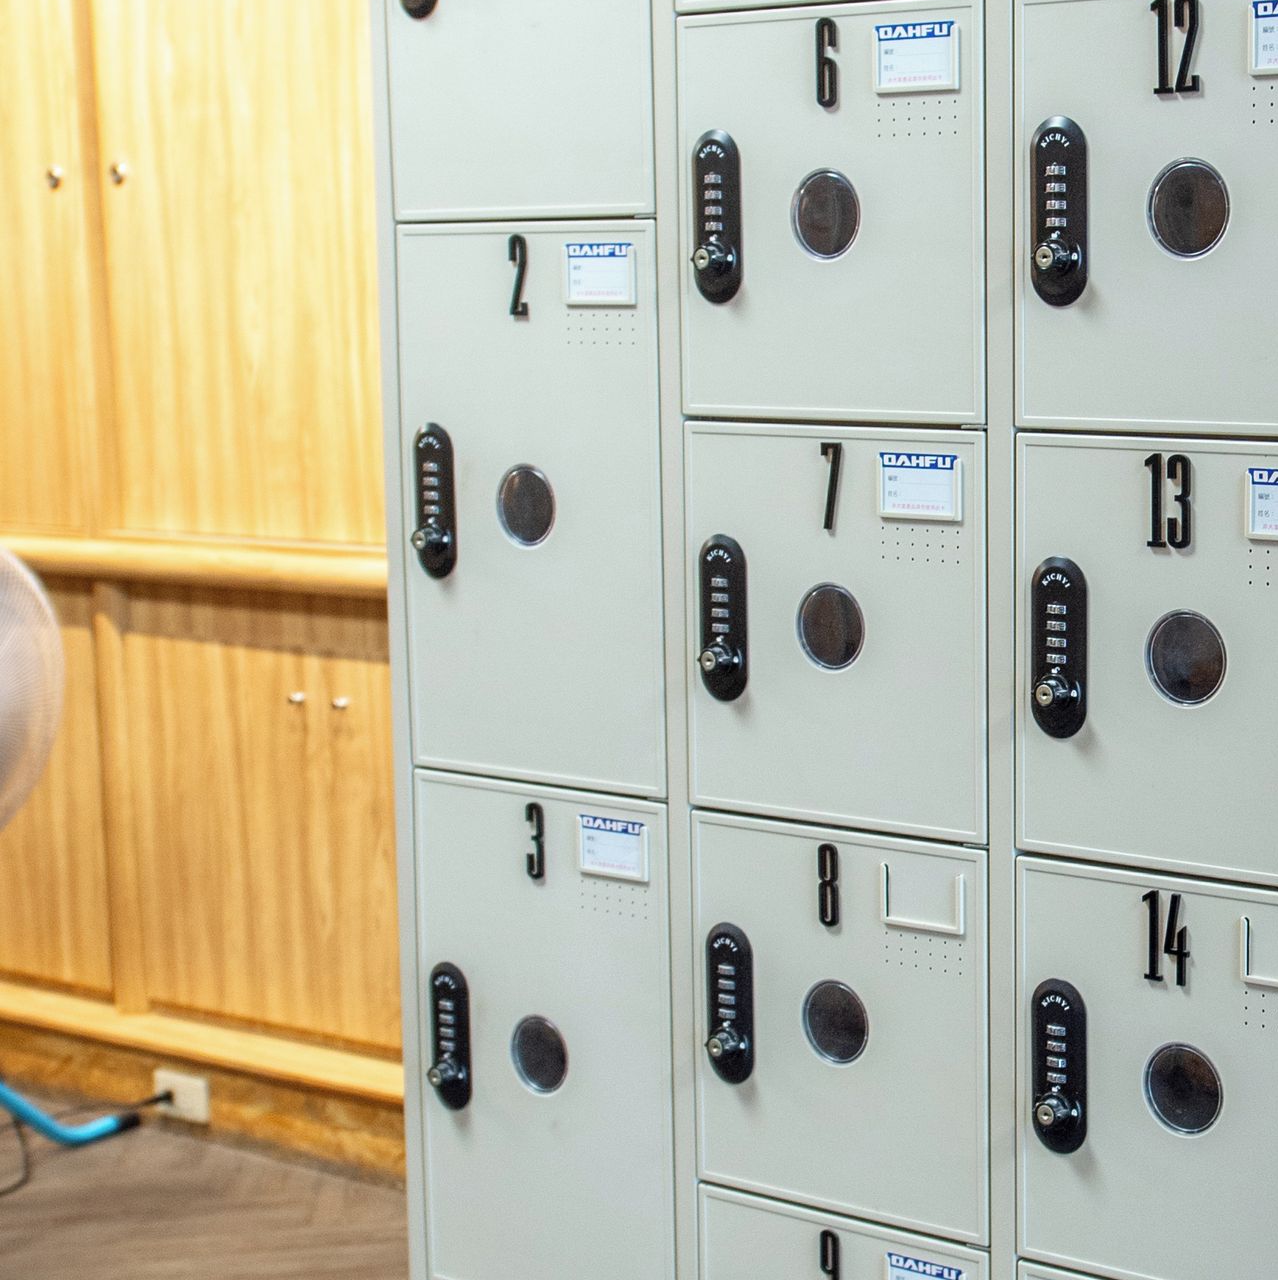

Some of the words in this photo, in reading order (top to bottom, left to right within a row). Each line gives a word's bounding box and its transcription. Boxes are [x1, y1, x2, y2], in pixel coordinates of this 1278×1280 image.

[879, 23, 948, 39] DAHFU
[816, 18, 837, 108] 6
[1041, 133, 1070, 148] KICHYI
[699, 144, 724, 159] KICHYI
[569, 245, 626, 255] DAHFU
[510, 235, 528, 316] 2
[884, 454, 951, 468] DAHFU
[821, 443, 842, 530] 7
[1145, 453, 1191, 549] 13
[706, 549, 731, 563] KICHYI
[1042, 573, 1071, 588] KICHYI
[583, 816, 641, 834] DAHFU
[526, 803, 544, 880] 3
[818, 844, 839, 927] 8
[713, 937, 737, 952] KICHYI
[1142, 890, 1190, 986] 14
[1041, 995, 1069, 1010] KICHYI
[891, 1254, 958, 1280] DAHFU
